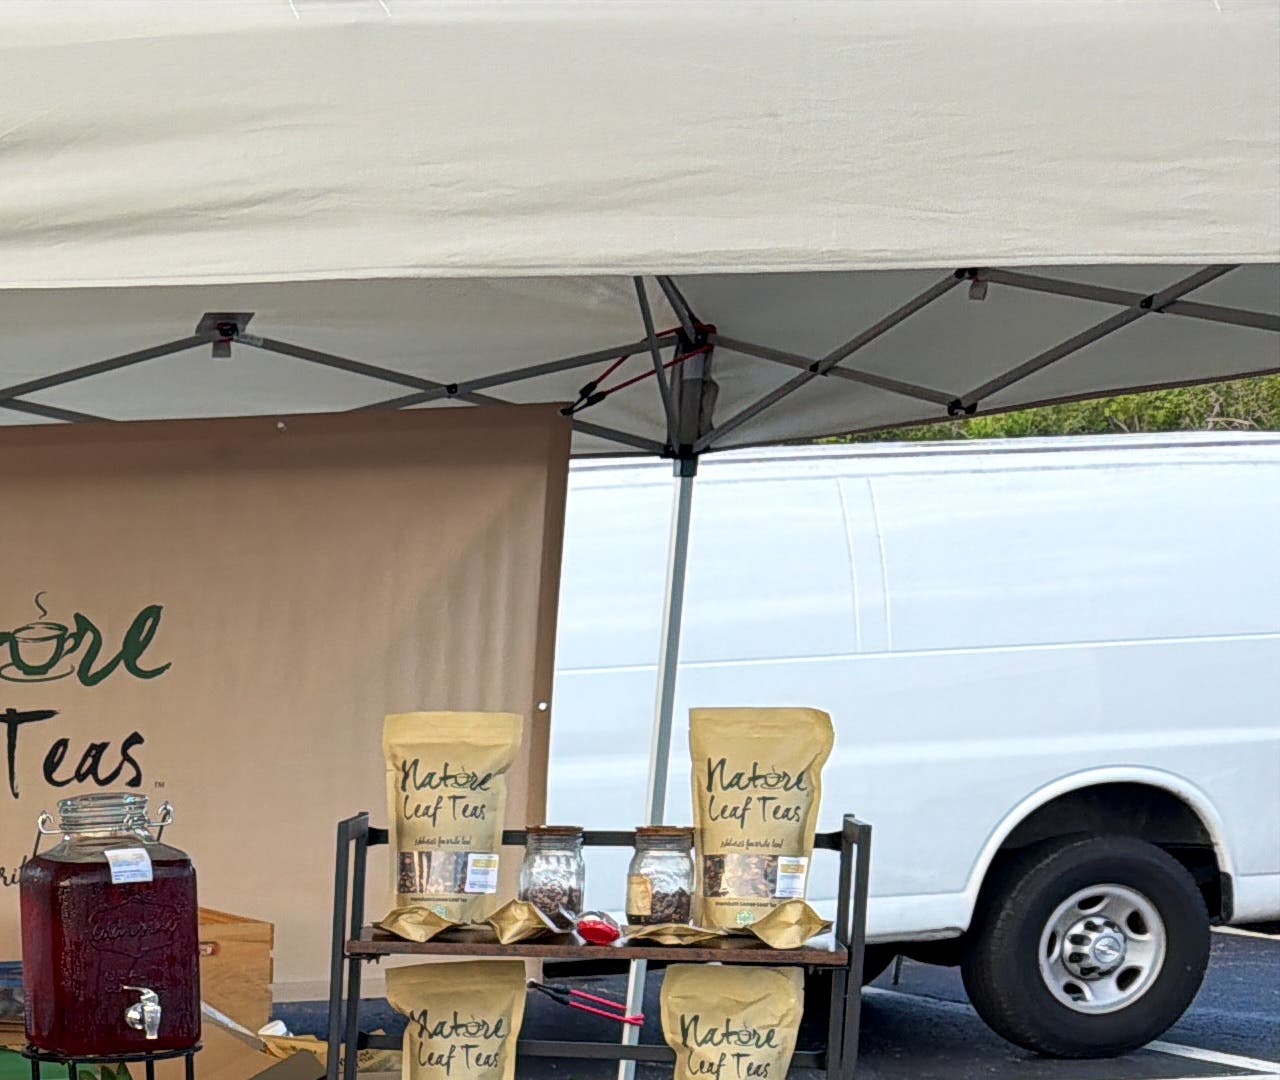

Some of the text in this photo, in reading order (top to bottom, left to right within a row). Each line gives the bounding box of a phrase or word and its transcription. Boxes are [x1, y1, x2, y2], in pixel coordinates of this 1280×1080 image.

[401, 759, 492, 792] Nature
[707, 757, 807, 793] Nature
[403, 796, 486, 827] Leaf Teas
[708, 796, 801, 829] Leaf Teas
[680, 1014, 778, 1048] Nature
[418, 1042, 499, 1076] Leaf Teas
[732, 1053, 770, 1079] Teas
